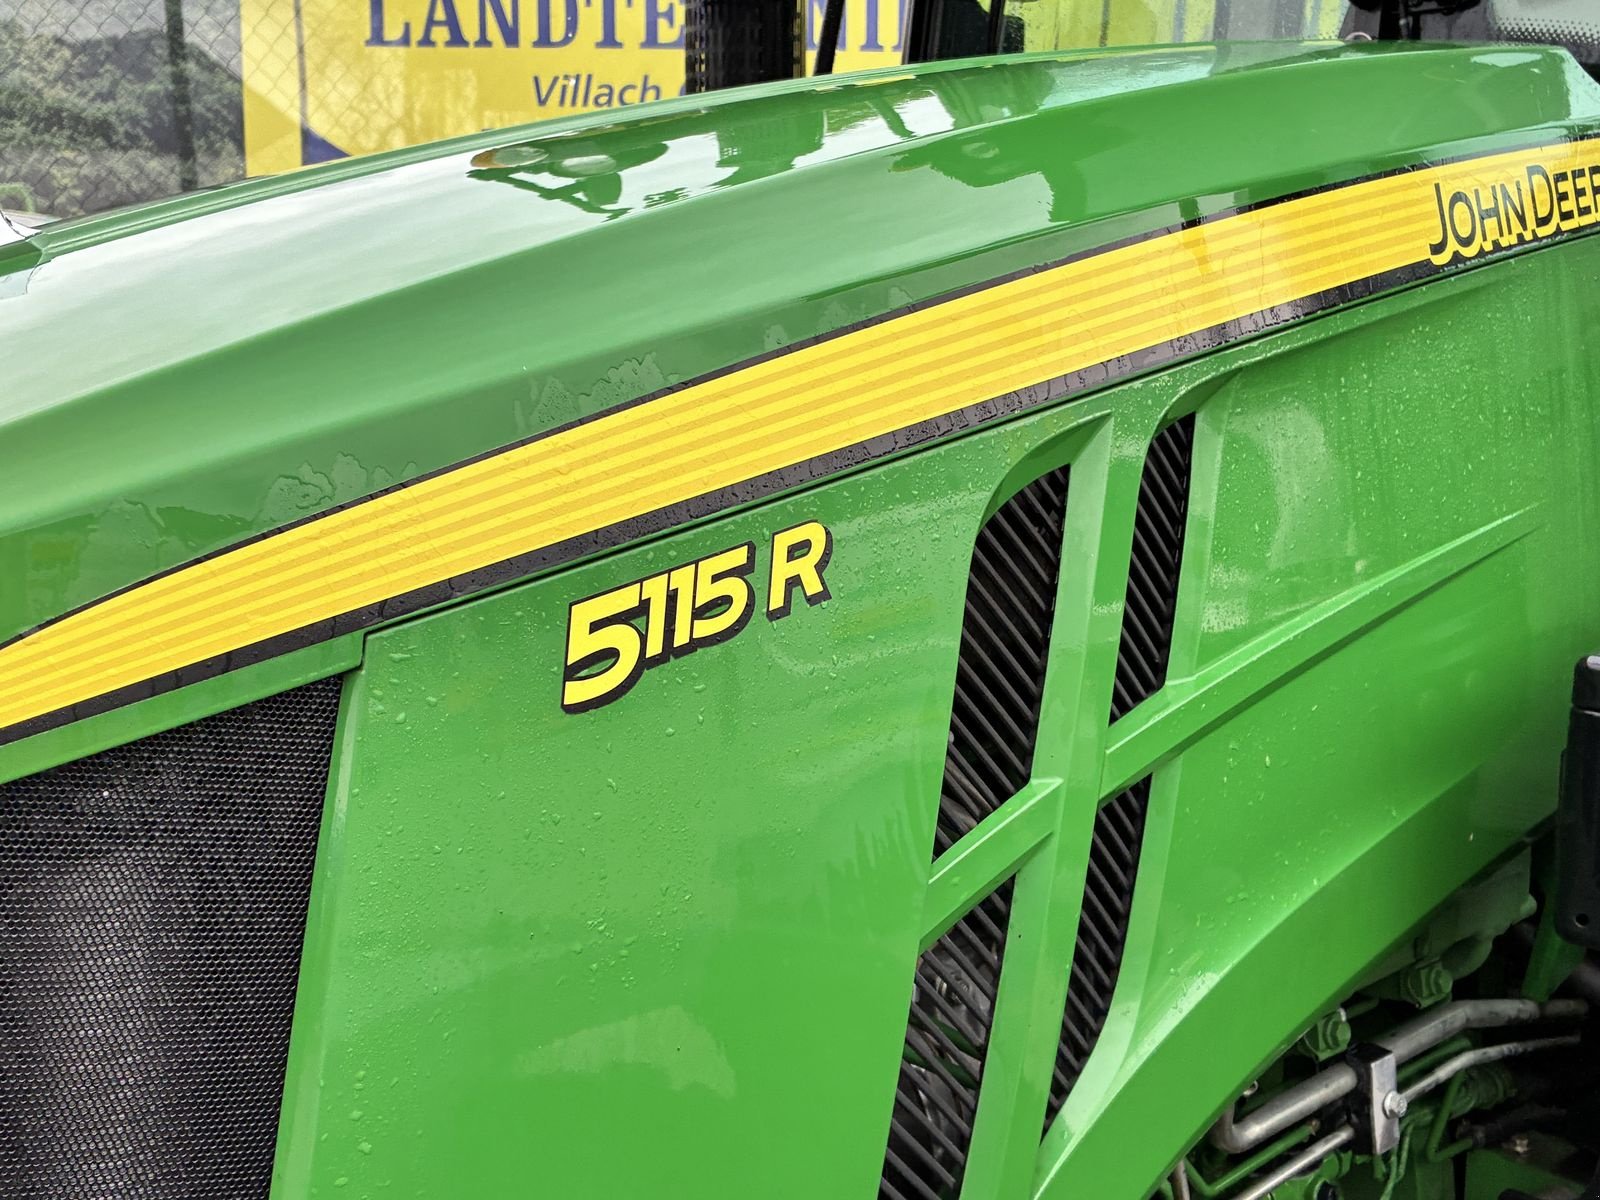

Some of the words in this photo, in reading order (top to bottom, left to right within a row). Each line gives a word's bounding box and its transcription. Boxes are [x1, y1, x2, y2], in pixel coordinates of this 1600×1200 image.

[532, 74, 662, 107] Villach
[1429, 180, 1529, 258] JOHN
[561, 540, 756, 714] 5115
[766, 519, 833, 621] R
